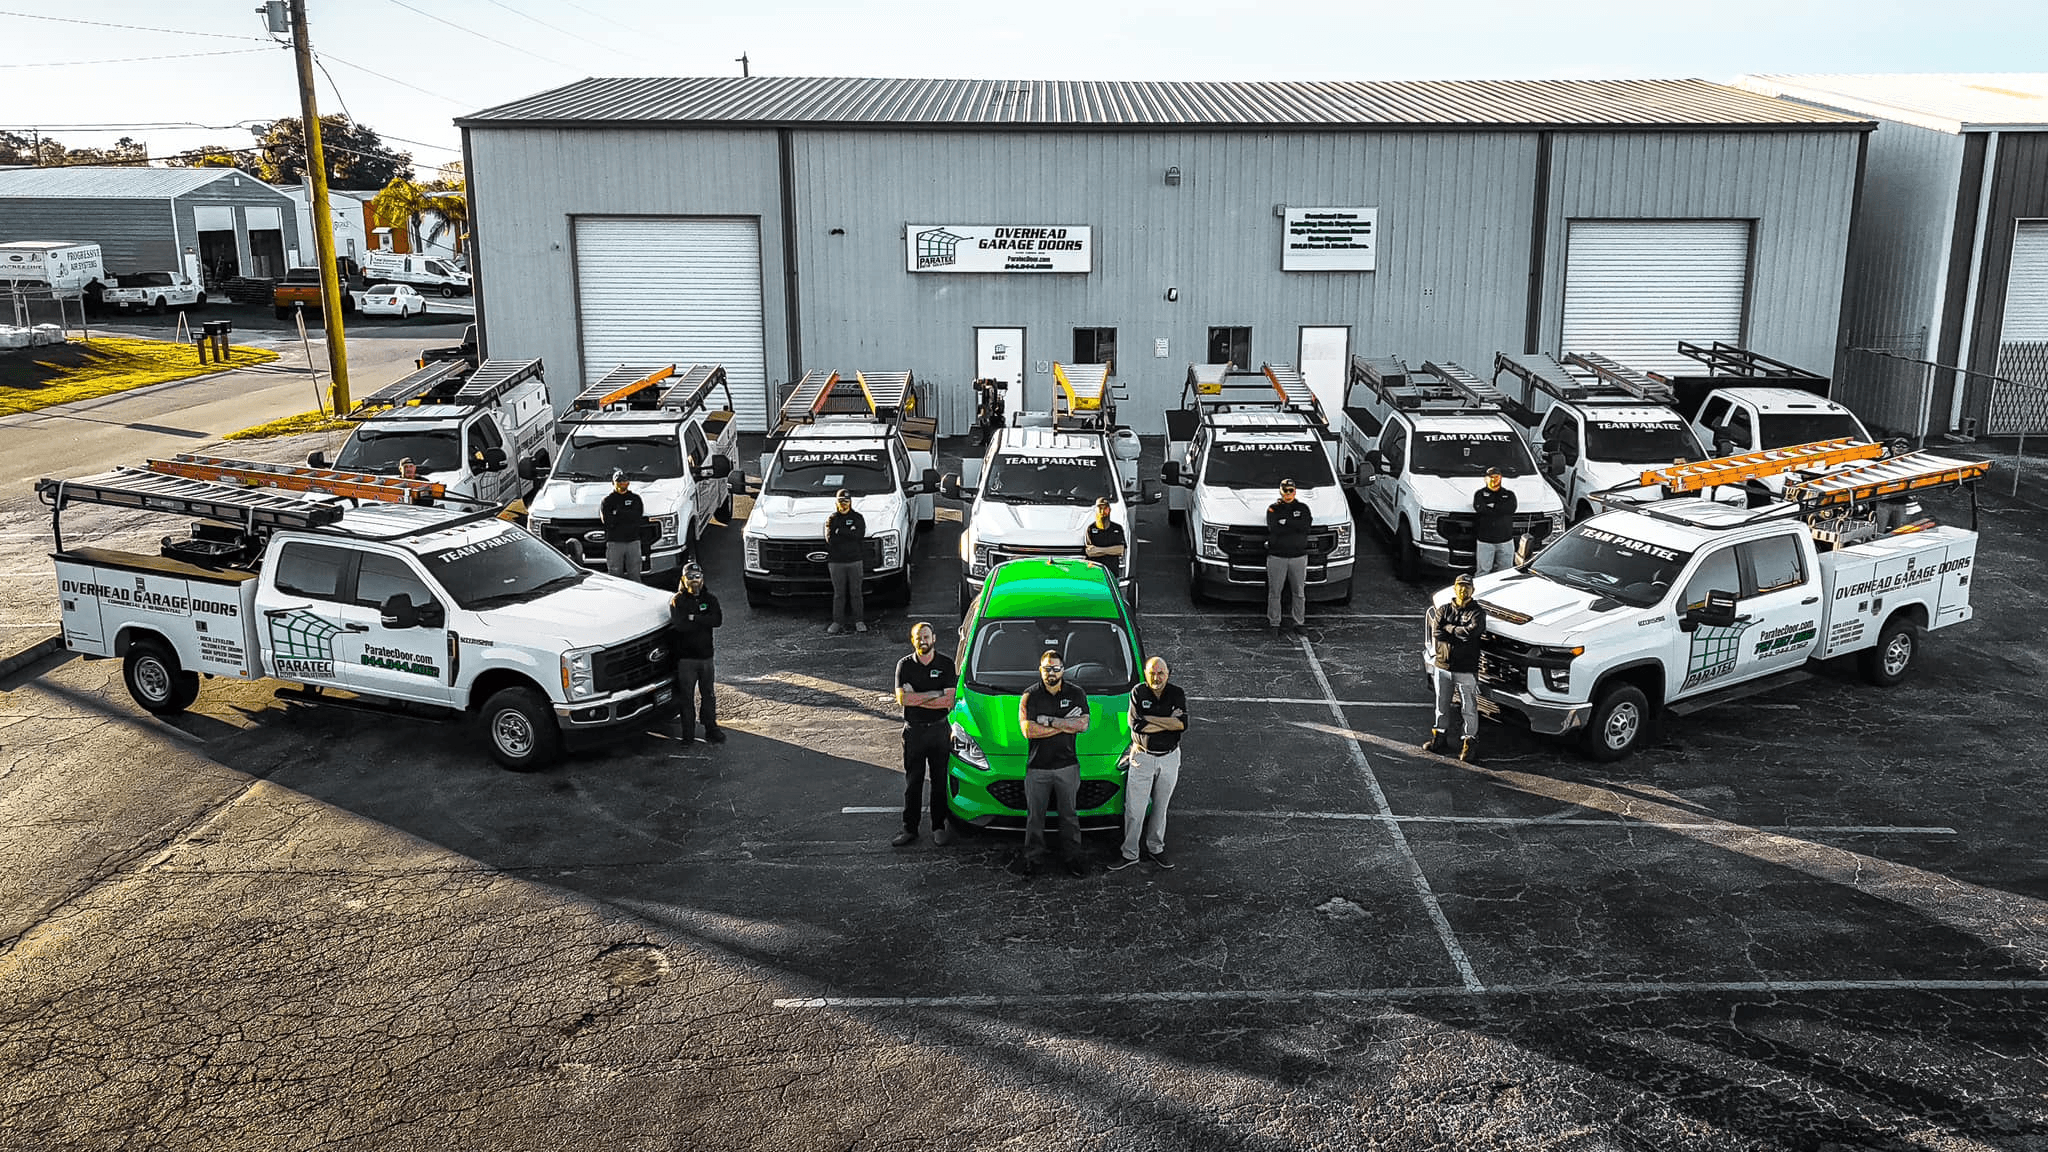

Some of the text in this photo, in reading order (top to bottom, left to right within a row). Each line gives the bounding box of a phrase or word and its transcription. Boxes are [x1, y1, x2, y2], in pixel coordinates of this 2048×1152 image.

[994, 228, 1067, 239] OVERHEAD
[978, 239, 1083, 251] GARAGE DOORS
[919, 256, 954, 265] PARATEC
[1597, 422, 1681, 431] TEAM PARATEC
[1424, 434, 1511, 442] TEAM PARATEC
[1223, 444, 1313, 452] TEAM PARATEC
[788, 453, 878, 463] TEAM PARATEC
[1005, 457, 1097, 467] TEAM PARATEC
[1580, 528, 1679, 561] TEAM PARATEC
[438, 545, 480, 563] TEAM
[1836, 556, 1971, 600] OVERHEAD GARAGE DOORS
[62, 580, 238, 617] OVERHEAD GARAGE DOORS
[1760, 620, 1813, 641] ParatecDoor.com
[365, 643, 433, 665] ParatecDoor.com
[277, 659, 332, 673] PARATEC
[1687, 660, 1735, 686] PARATEC
